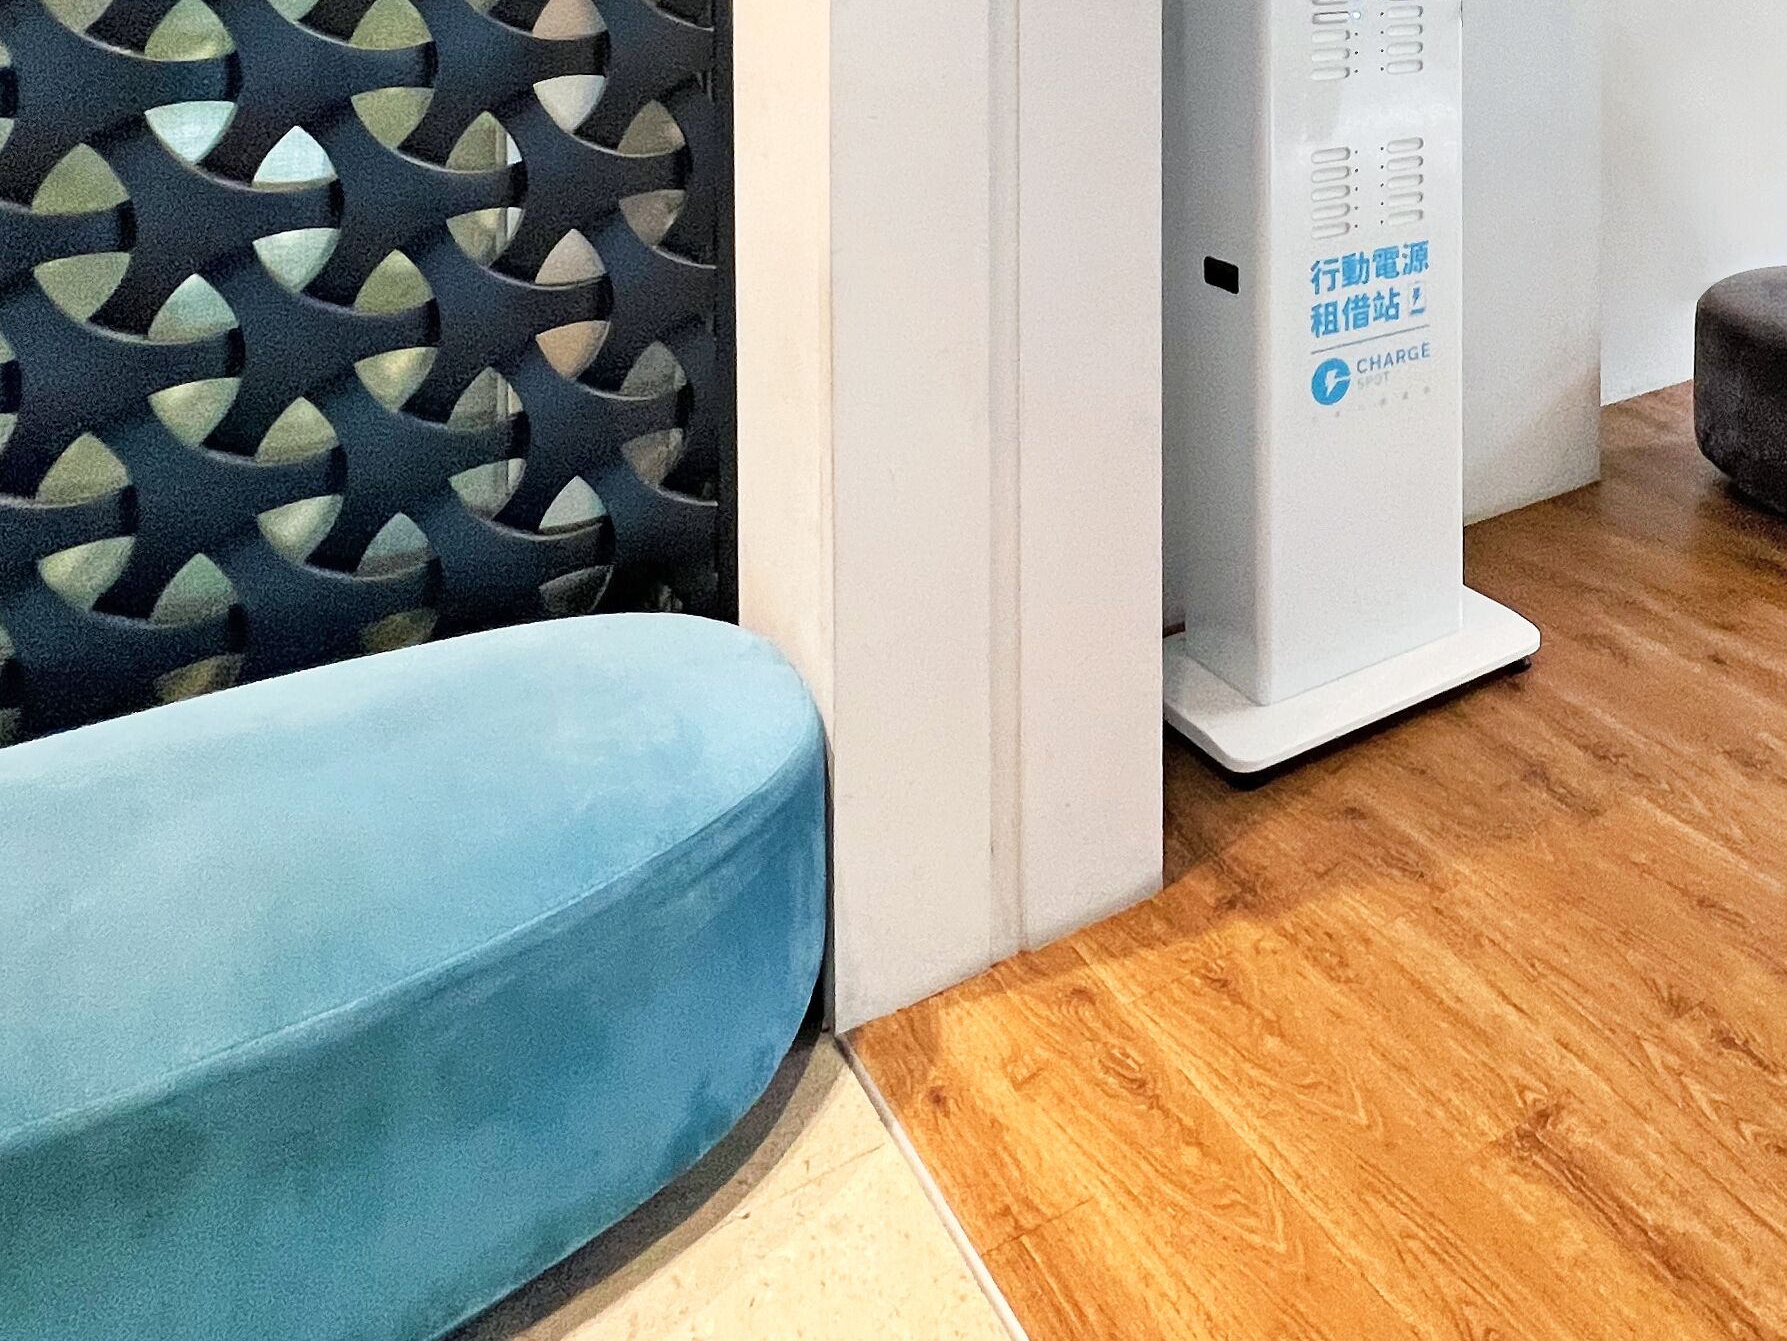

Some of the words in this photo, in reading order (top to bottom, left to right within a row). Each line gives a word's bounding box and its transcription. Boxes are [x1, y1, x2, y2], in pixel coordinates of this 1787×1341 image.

[1310, 240, 1429, 295] 行動電源
[1310, 287, 1400, 338] 租借站
[1356, 342, 1431, 374] CHARGE
[1357, 371, 1390, 391] SPOT
